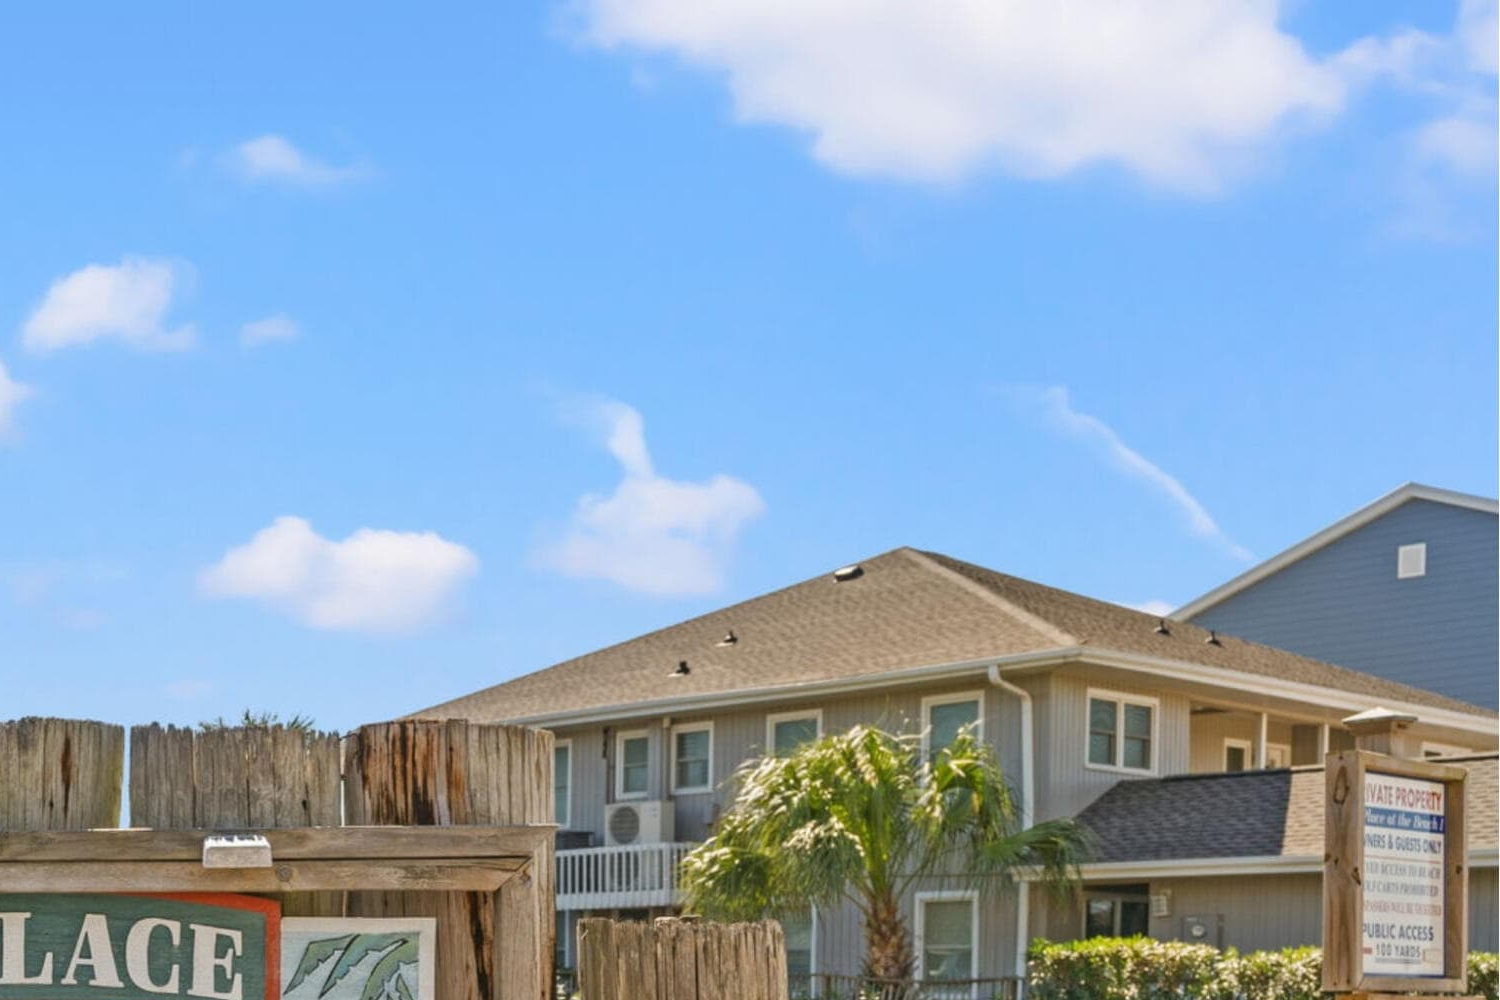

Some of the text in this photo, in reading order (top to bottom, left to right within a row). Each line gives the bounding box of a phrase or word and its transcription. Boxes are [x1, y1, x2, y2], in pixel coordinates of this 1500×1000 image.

[1364, 783, 1442, 812] IVATE PROPERTY
[1413, 814, 1438, 831] Beach
[1364, 833, 1442, 855] NERS & GUESTS ONLY
[1363, 922, 1435, 941] PUBLIC ACCESS
[1395, 944, 1421, 958] YARDS
